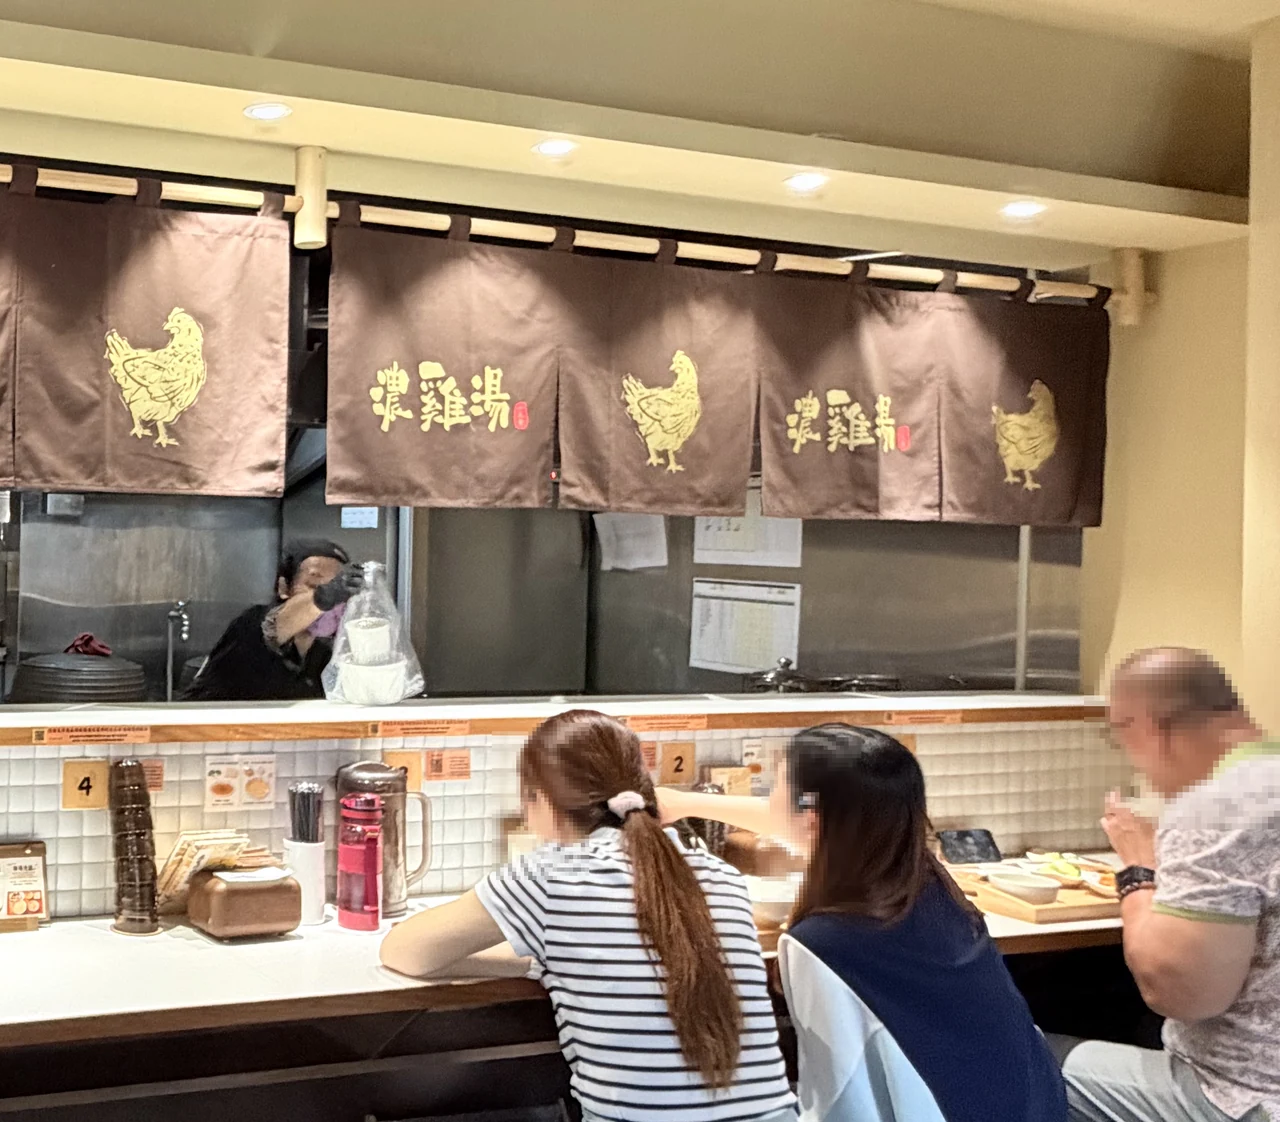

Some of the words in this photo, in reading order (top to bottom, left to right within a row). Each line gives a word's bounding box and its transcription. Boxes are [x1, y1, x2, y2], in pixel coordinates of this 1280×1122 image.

[369, 360, 511, 432] 濃雞湯
[785, 389, 895, 453] 濃雞湯
[673, 755, 685, 773] 2
[77, 776, 92, 796] 4
